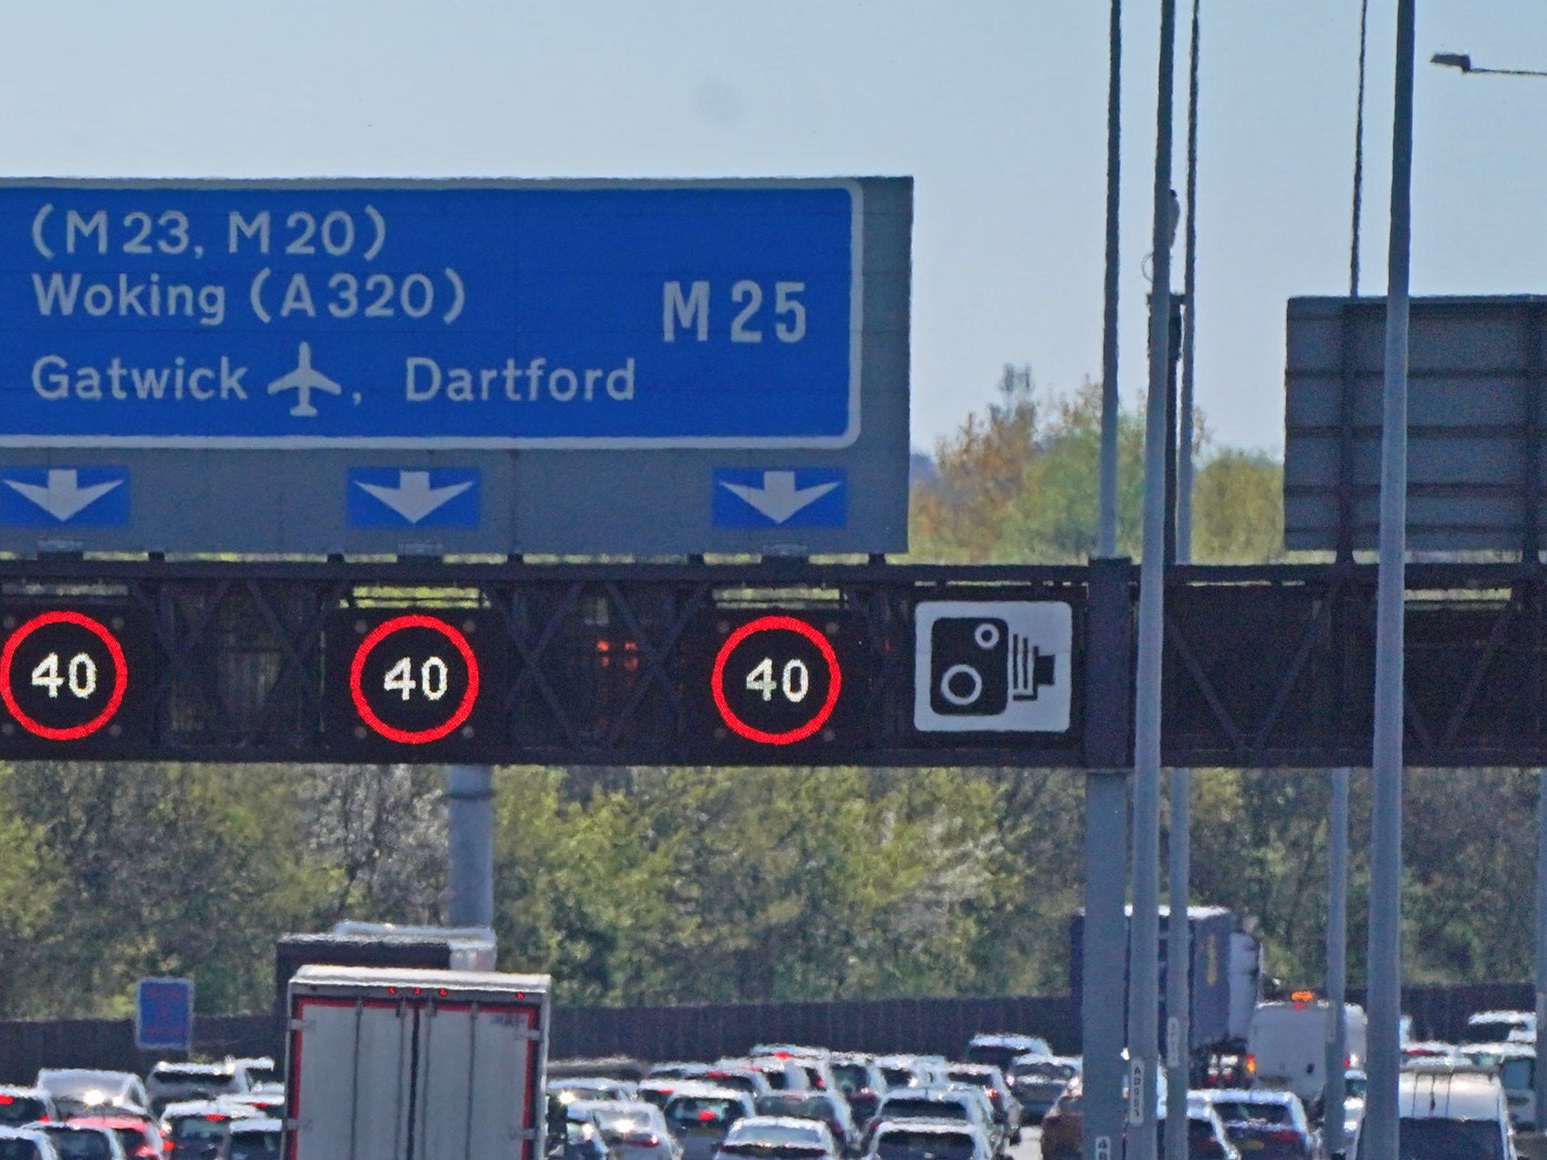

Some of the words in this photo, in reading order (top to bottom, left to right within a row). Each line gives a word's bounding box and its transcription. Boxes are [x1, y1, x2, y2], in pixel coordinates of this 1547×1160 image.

[32, 272, 225, 325] Woking
[32, 355, 249, 401] Gatwick
[406, 357, 635, 401] Dartford
[31, 652, 97, 698] 40
[384, 657, 447, 700] 40
[747, 657, 808, 702] 40
